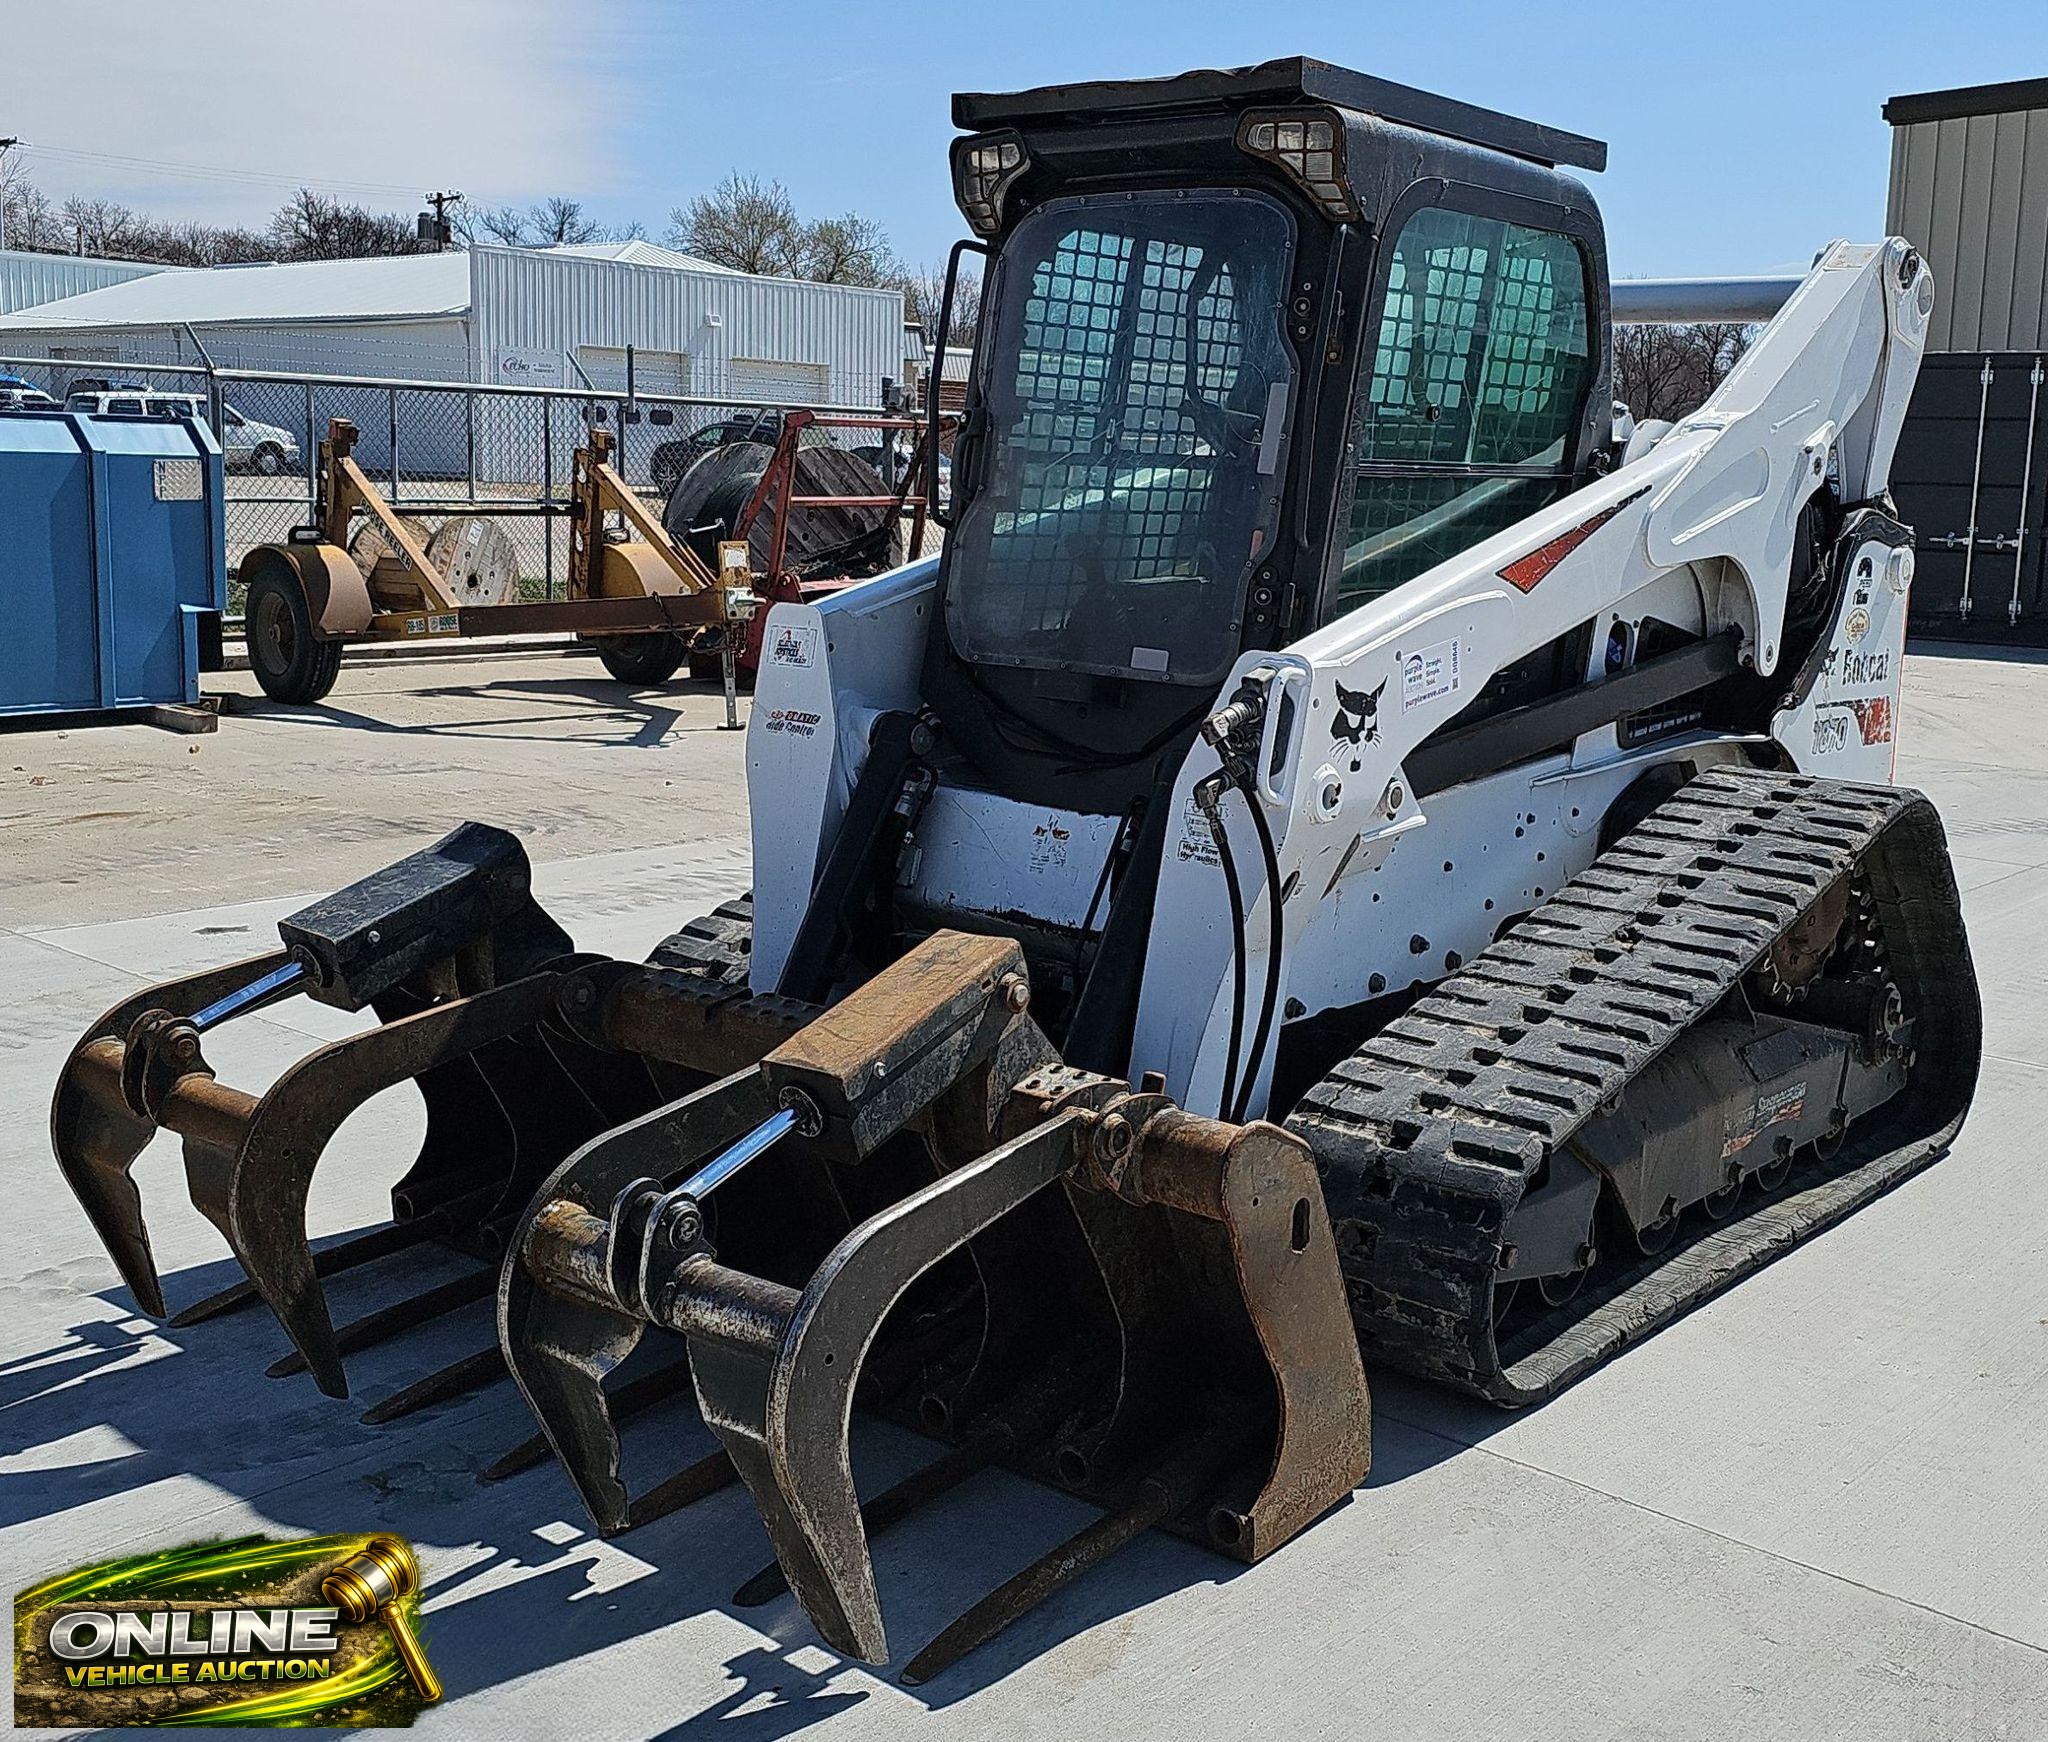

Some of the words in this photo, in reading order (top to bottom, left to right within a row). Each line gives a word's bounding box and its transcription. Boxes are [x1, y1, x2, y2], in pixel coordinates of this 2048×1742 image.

[384, 530, 412, 569] REELER
[1405, 663, 1422, 677] purple
[1408, 674, 1422, 683] wave
[1406, 686, 1449, 708] purplewave.com
[785, 721, 814, 737] Control
[1183, 843, 1199, 852] High
[1201, 847, 1218, 855] Flow
